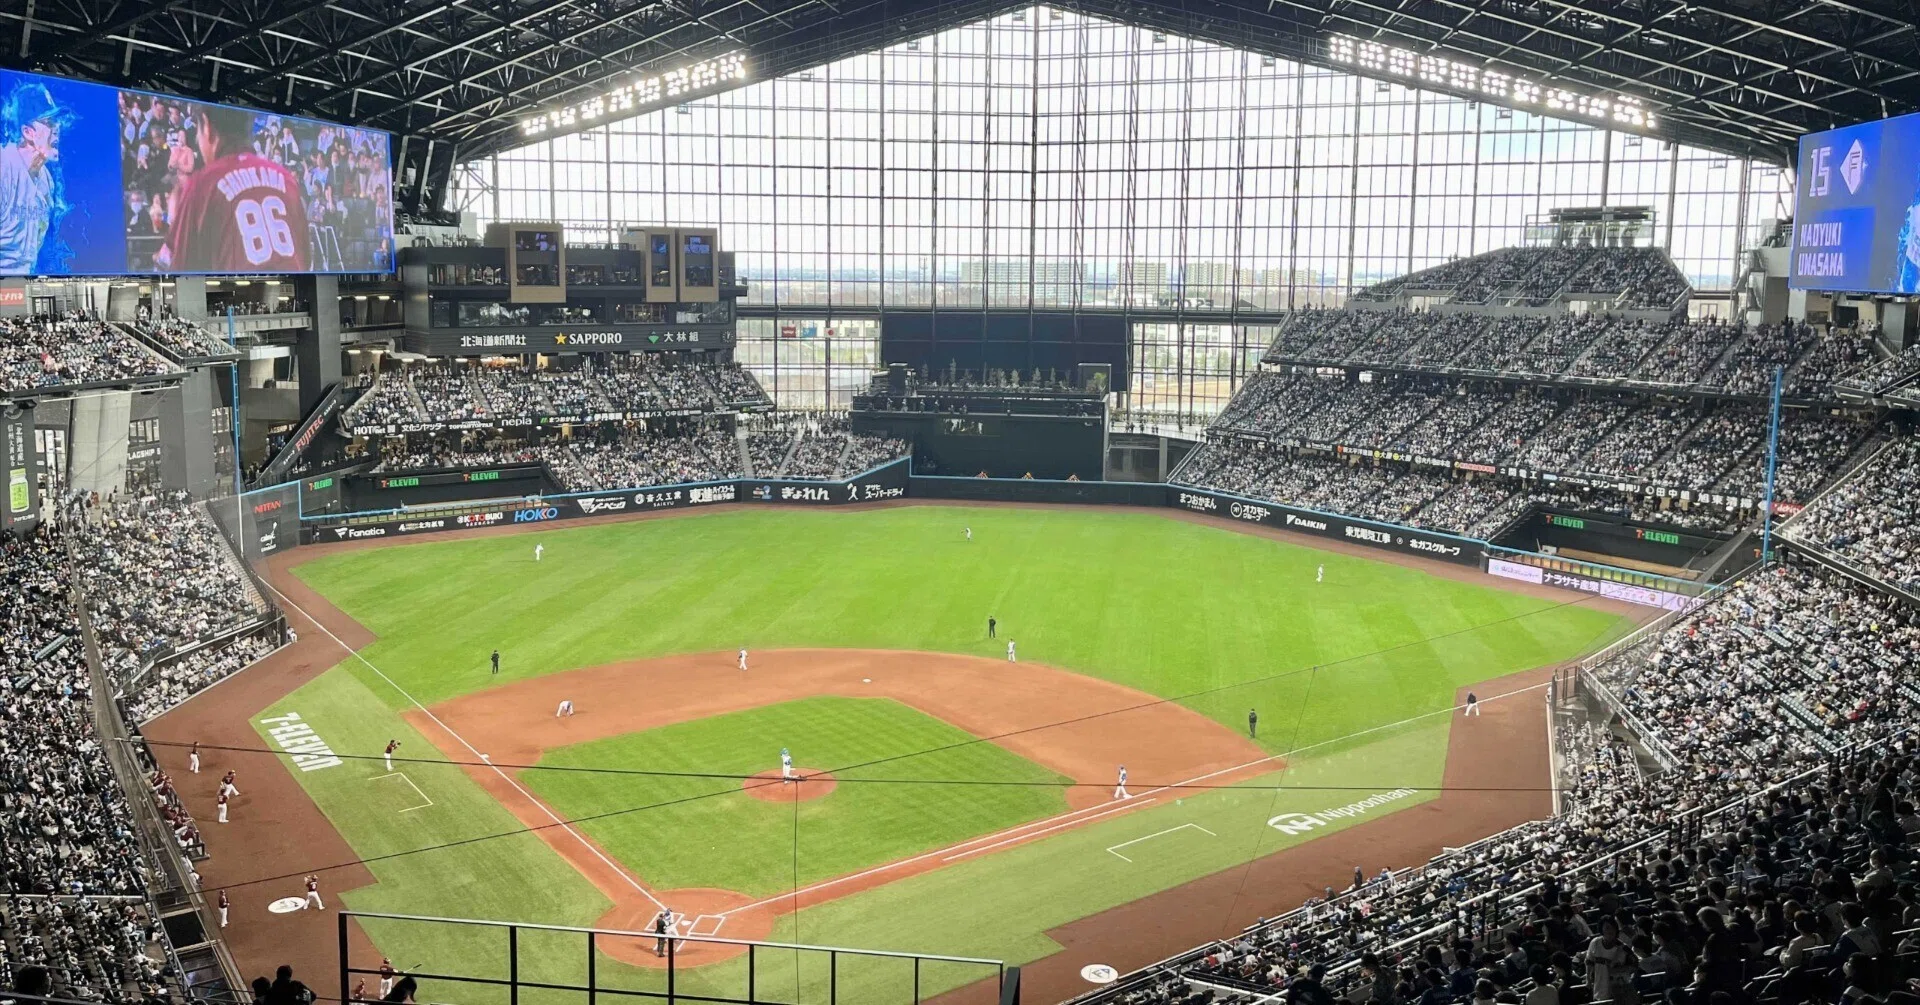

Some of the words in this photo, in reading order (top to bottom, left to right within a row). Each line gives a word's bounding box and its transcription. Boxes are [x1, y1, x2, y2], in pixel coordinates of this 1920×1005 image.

[1809, 146, 1831, 197] 15
[235, 195, 295, 265] 86
[1800, 222, 1842, 247] NAOYUKI
[461, 334, 527, 347] 北海道新聞社
[569, 332, 622, 345] SAPPORO
[663, 331, 699, 343] 大林組
[402, 422, 447, 433] 文化シャッター
[501, 417, 532, 427] nepia
[295, 414, 324, 452] FUJITEC
[781, 486, 830, 501] ぎょれん
[864, 483, 881, 491] アサヒ
[864, 487, 904, 500] スーパードライ
[689, 487, 713, 504] 東進
[463, 511, 504, 524] KOTOBUKI
[514, 507, 558, 523] HOKKO
[1242, 504, 1271, 518] オカモト
[1294, 518, 1327, 531] DAIKIN
[348, 526, 386, 538] Fanatics
[1409, 538, 1461, 556] 北ガスグループ
[1544, 571, 1600, 593] ナラサキ産業
[1315, 786, 1418, 821] Nipponham
